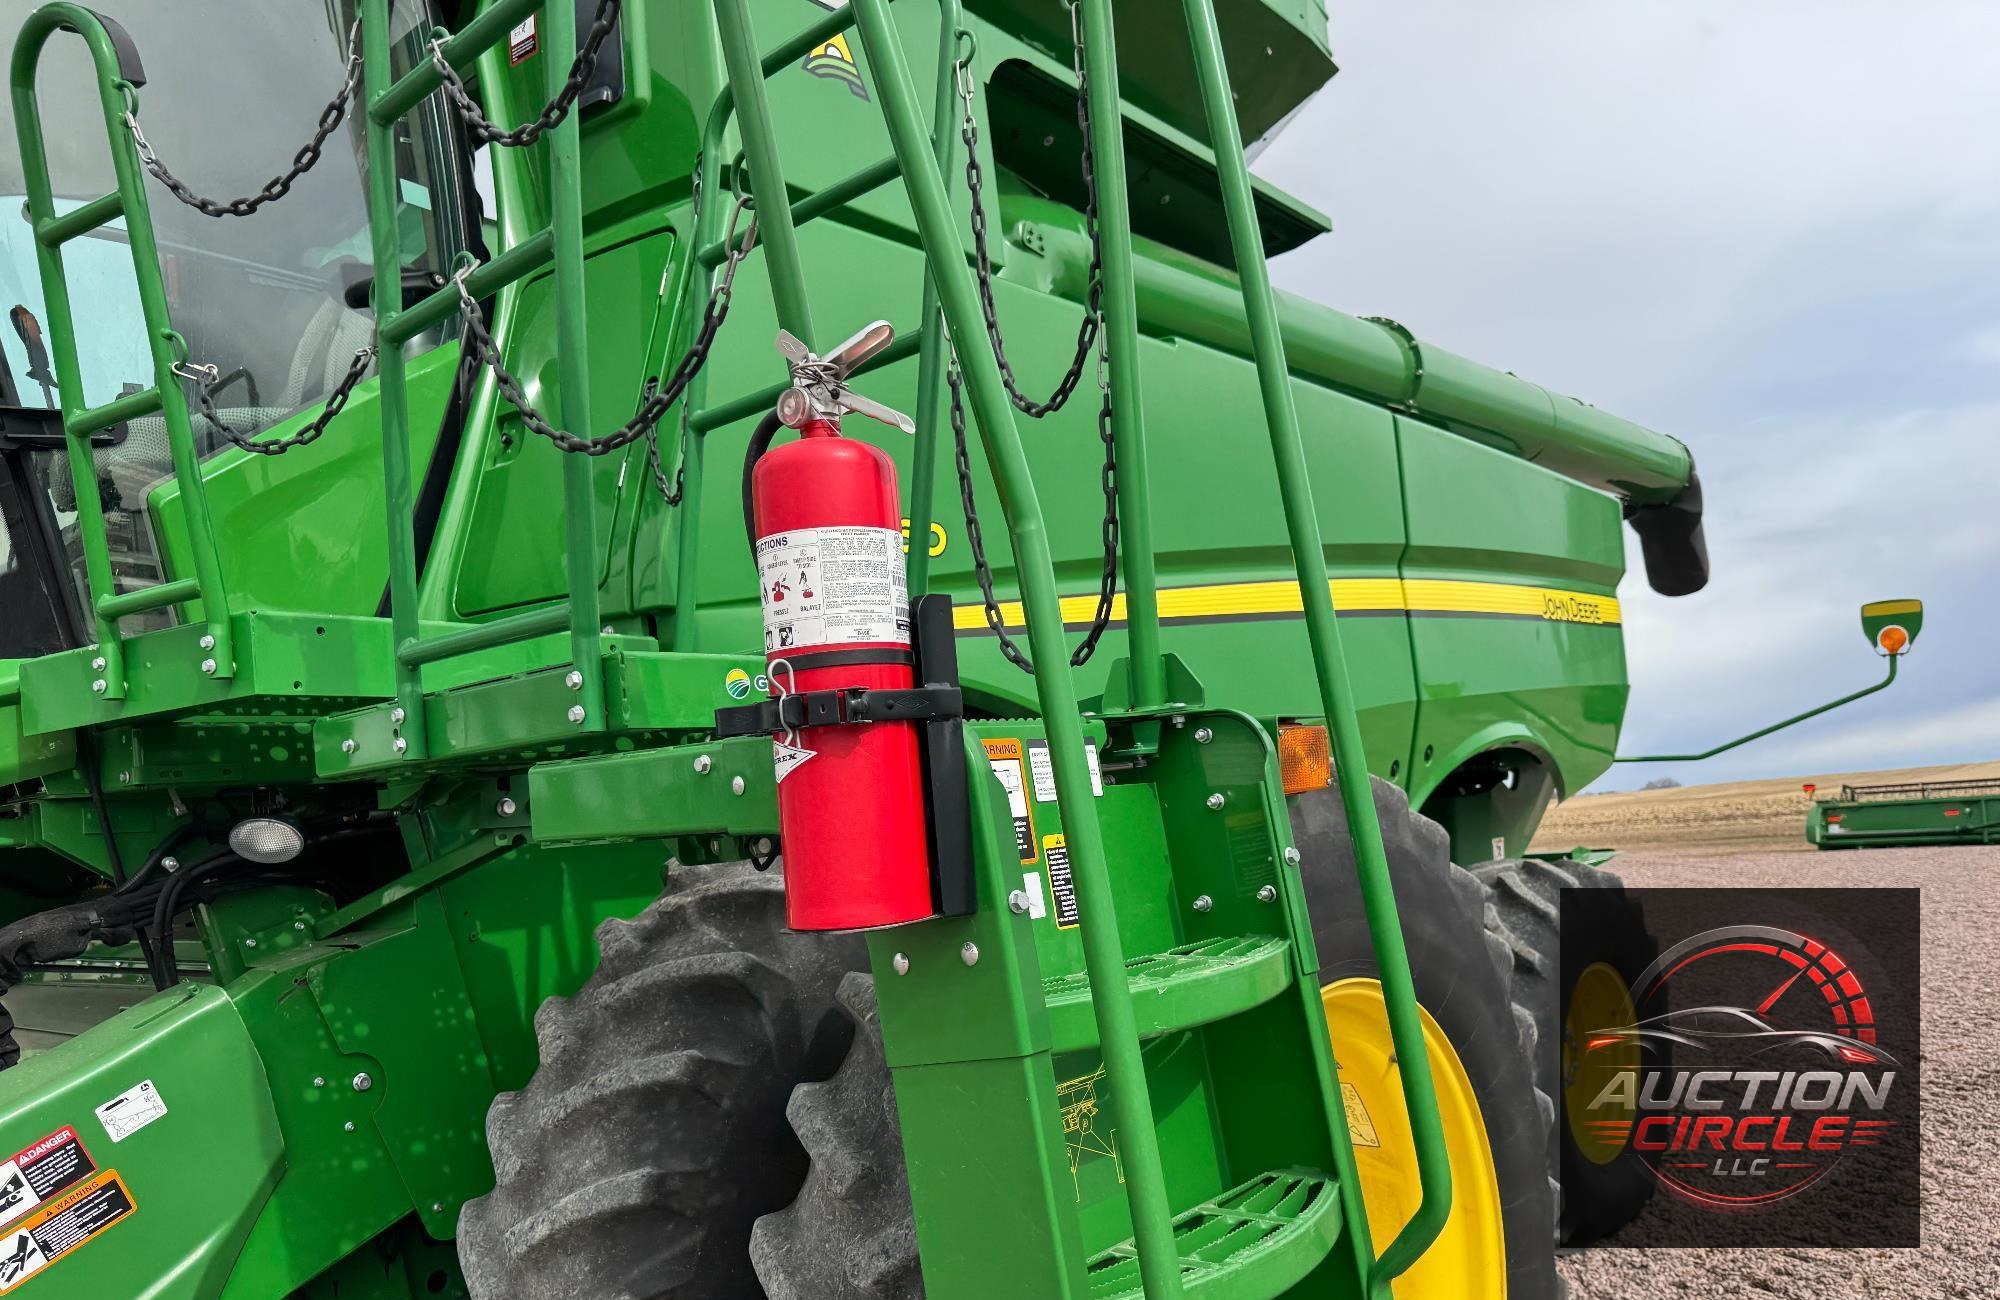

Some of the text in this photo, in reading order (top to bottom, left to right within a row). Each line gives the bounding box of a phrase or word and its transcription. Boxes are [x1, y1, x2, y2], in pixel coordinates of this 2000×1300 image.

[1541, 592, 1601, 620] JOHN DEERE
[27, 1129, 72, 1159] DANGER
[55, 1181, 99, 1210] WARNING
